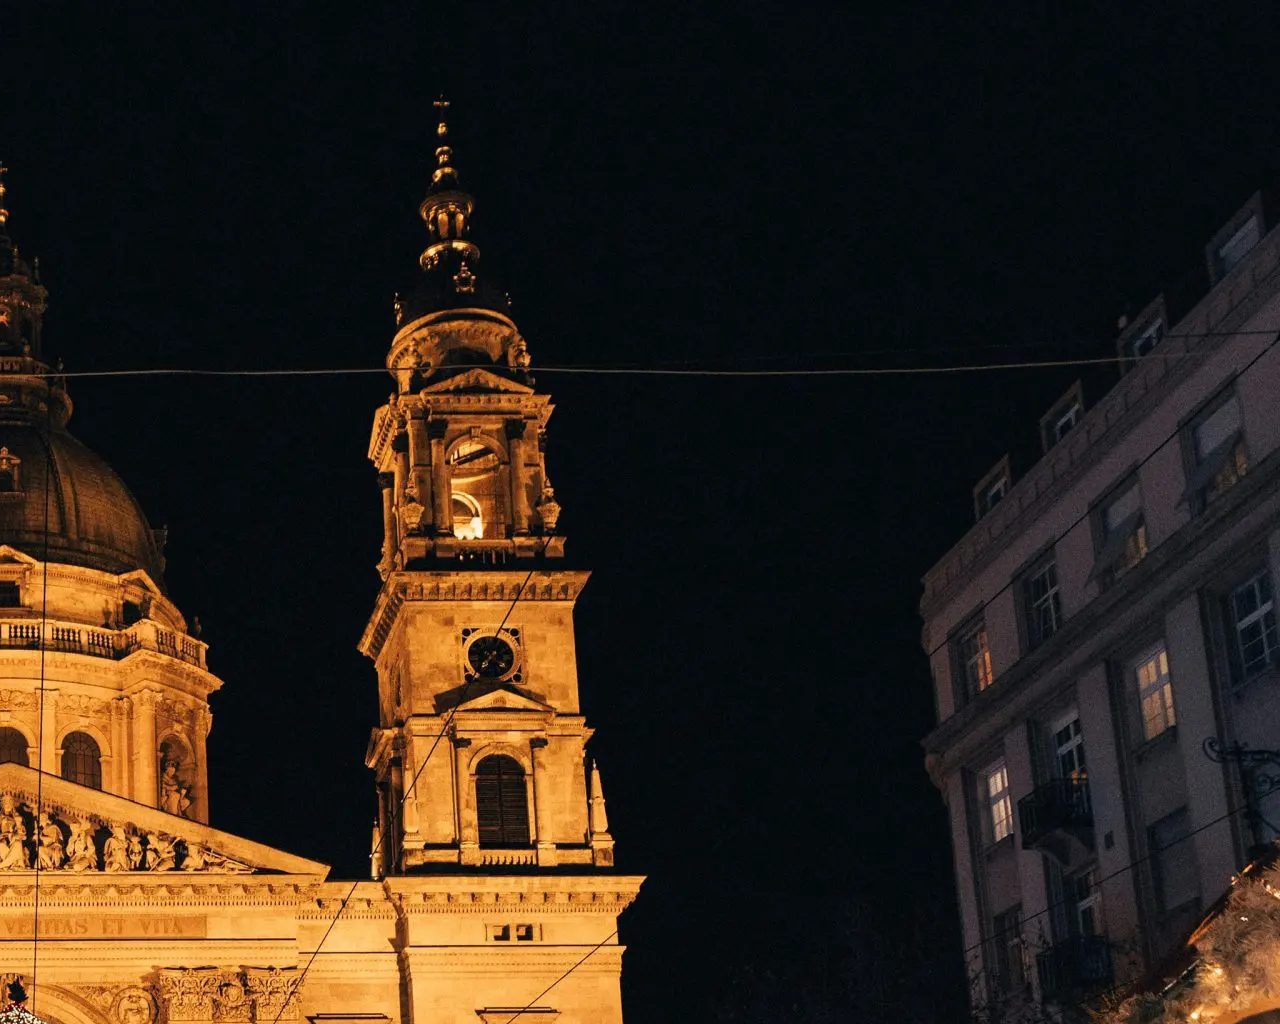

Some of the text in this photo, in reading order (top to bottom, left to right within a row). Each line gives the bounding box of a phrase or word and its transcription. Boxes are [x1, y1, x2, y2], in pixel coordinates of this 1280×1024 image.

[4, 917, 89, 935] VERITAS
[101, 917, 127, 935] ET
[138, 917, 183, 935] VITA
